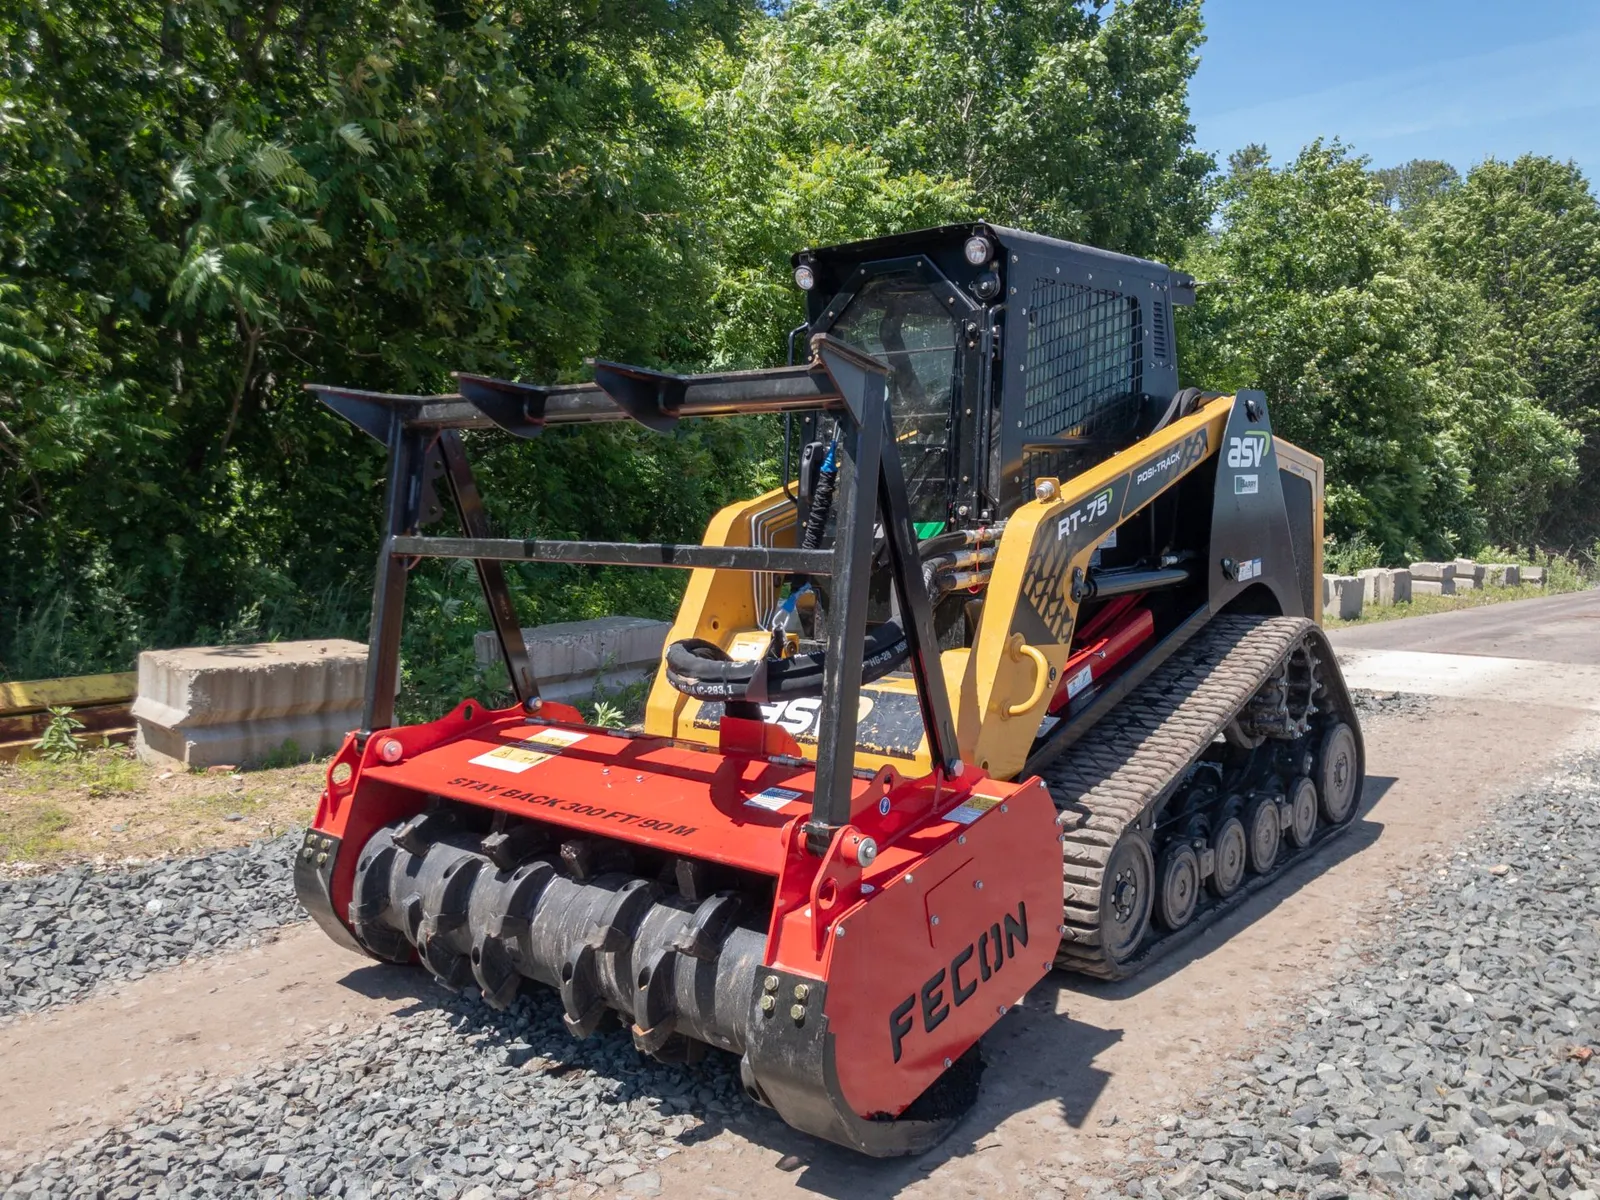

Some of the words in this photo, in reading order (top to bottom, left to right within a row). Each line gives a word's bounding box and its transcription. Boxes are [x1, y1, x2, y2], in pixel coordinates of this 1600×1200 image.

[1137, 451, 1180, 485] POSI-TRACK
[1058, 494, 1108, 540] RT-75
[447, 777, 505, 793] STAY
[500, 789, 566, 807] BACK
[560, 802, 607, 817] 300
[889, 900, 1029, 1064] FECON
